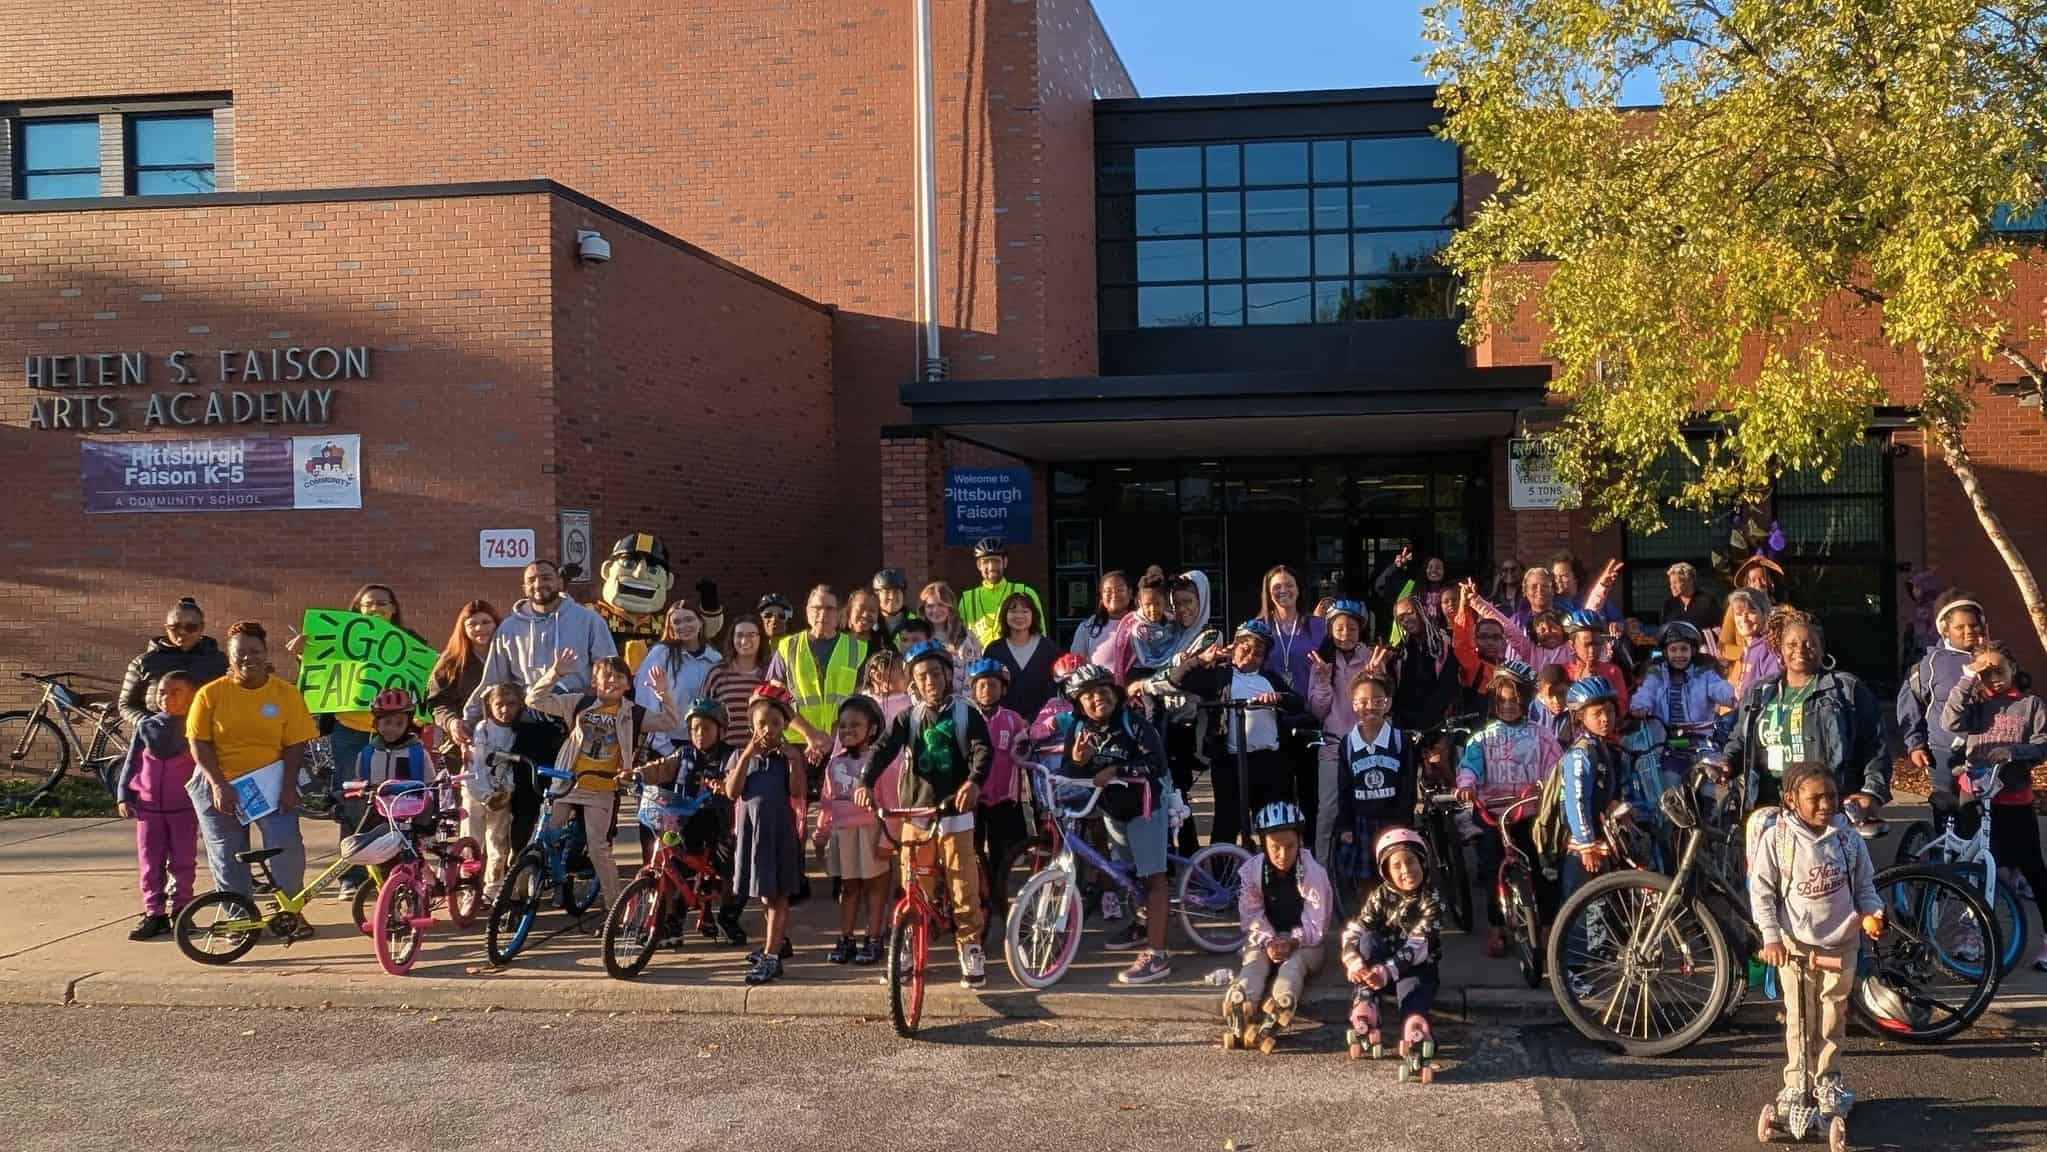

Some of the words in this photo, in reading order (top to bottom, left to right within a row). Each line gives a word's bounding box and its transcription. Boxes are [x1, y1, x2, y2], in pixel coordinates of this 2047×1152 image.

[25, 352, 146, 387] HELEN
[219, 346, 368, 382] FAISON
[27, 394, 115, 429] ARTS
[144, 388, 331, 427] ACADEMY
[132, 445, 244, 467] Pittsburgh
[125, 468, 196, 486] Faison
[954, 474, 998, 484] Welcome
[1000, 474, 1010, 482] to
[944, 487, 1022, 503] Pittsburgh
[1528, 487, 1535, 496] 5
[1540, 486, 1562, 496] TONS
[115, 497, 123, 507] A
[129, 496, 202, 507] COMMUNITY
[209, 494, 262, 505] SCHOOL
[957, 505, 1008, 519] Faison
[485, 538, 529, 558] 7430
[342, 617, 407, 667] GO
